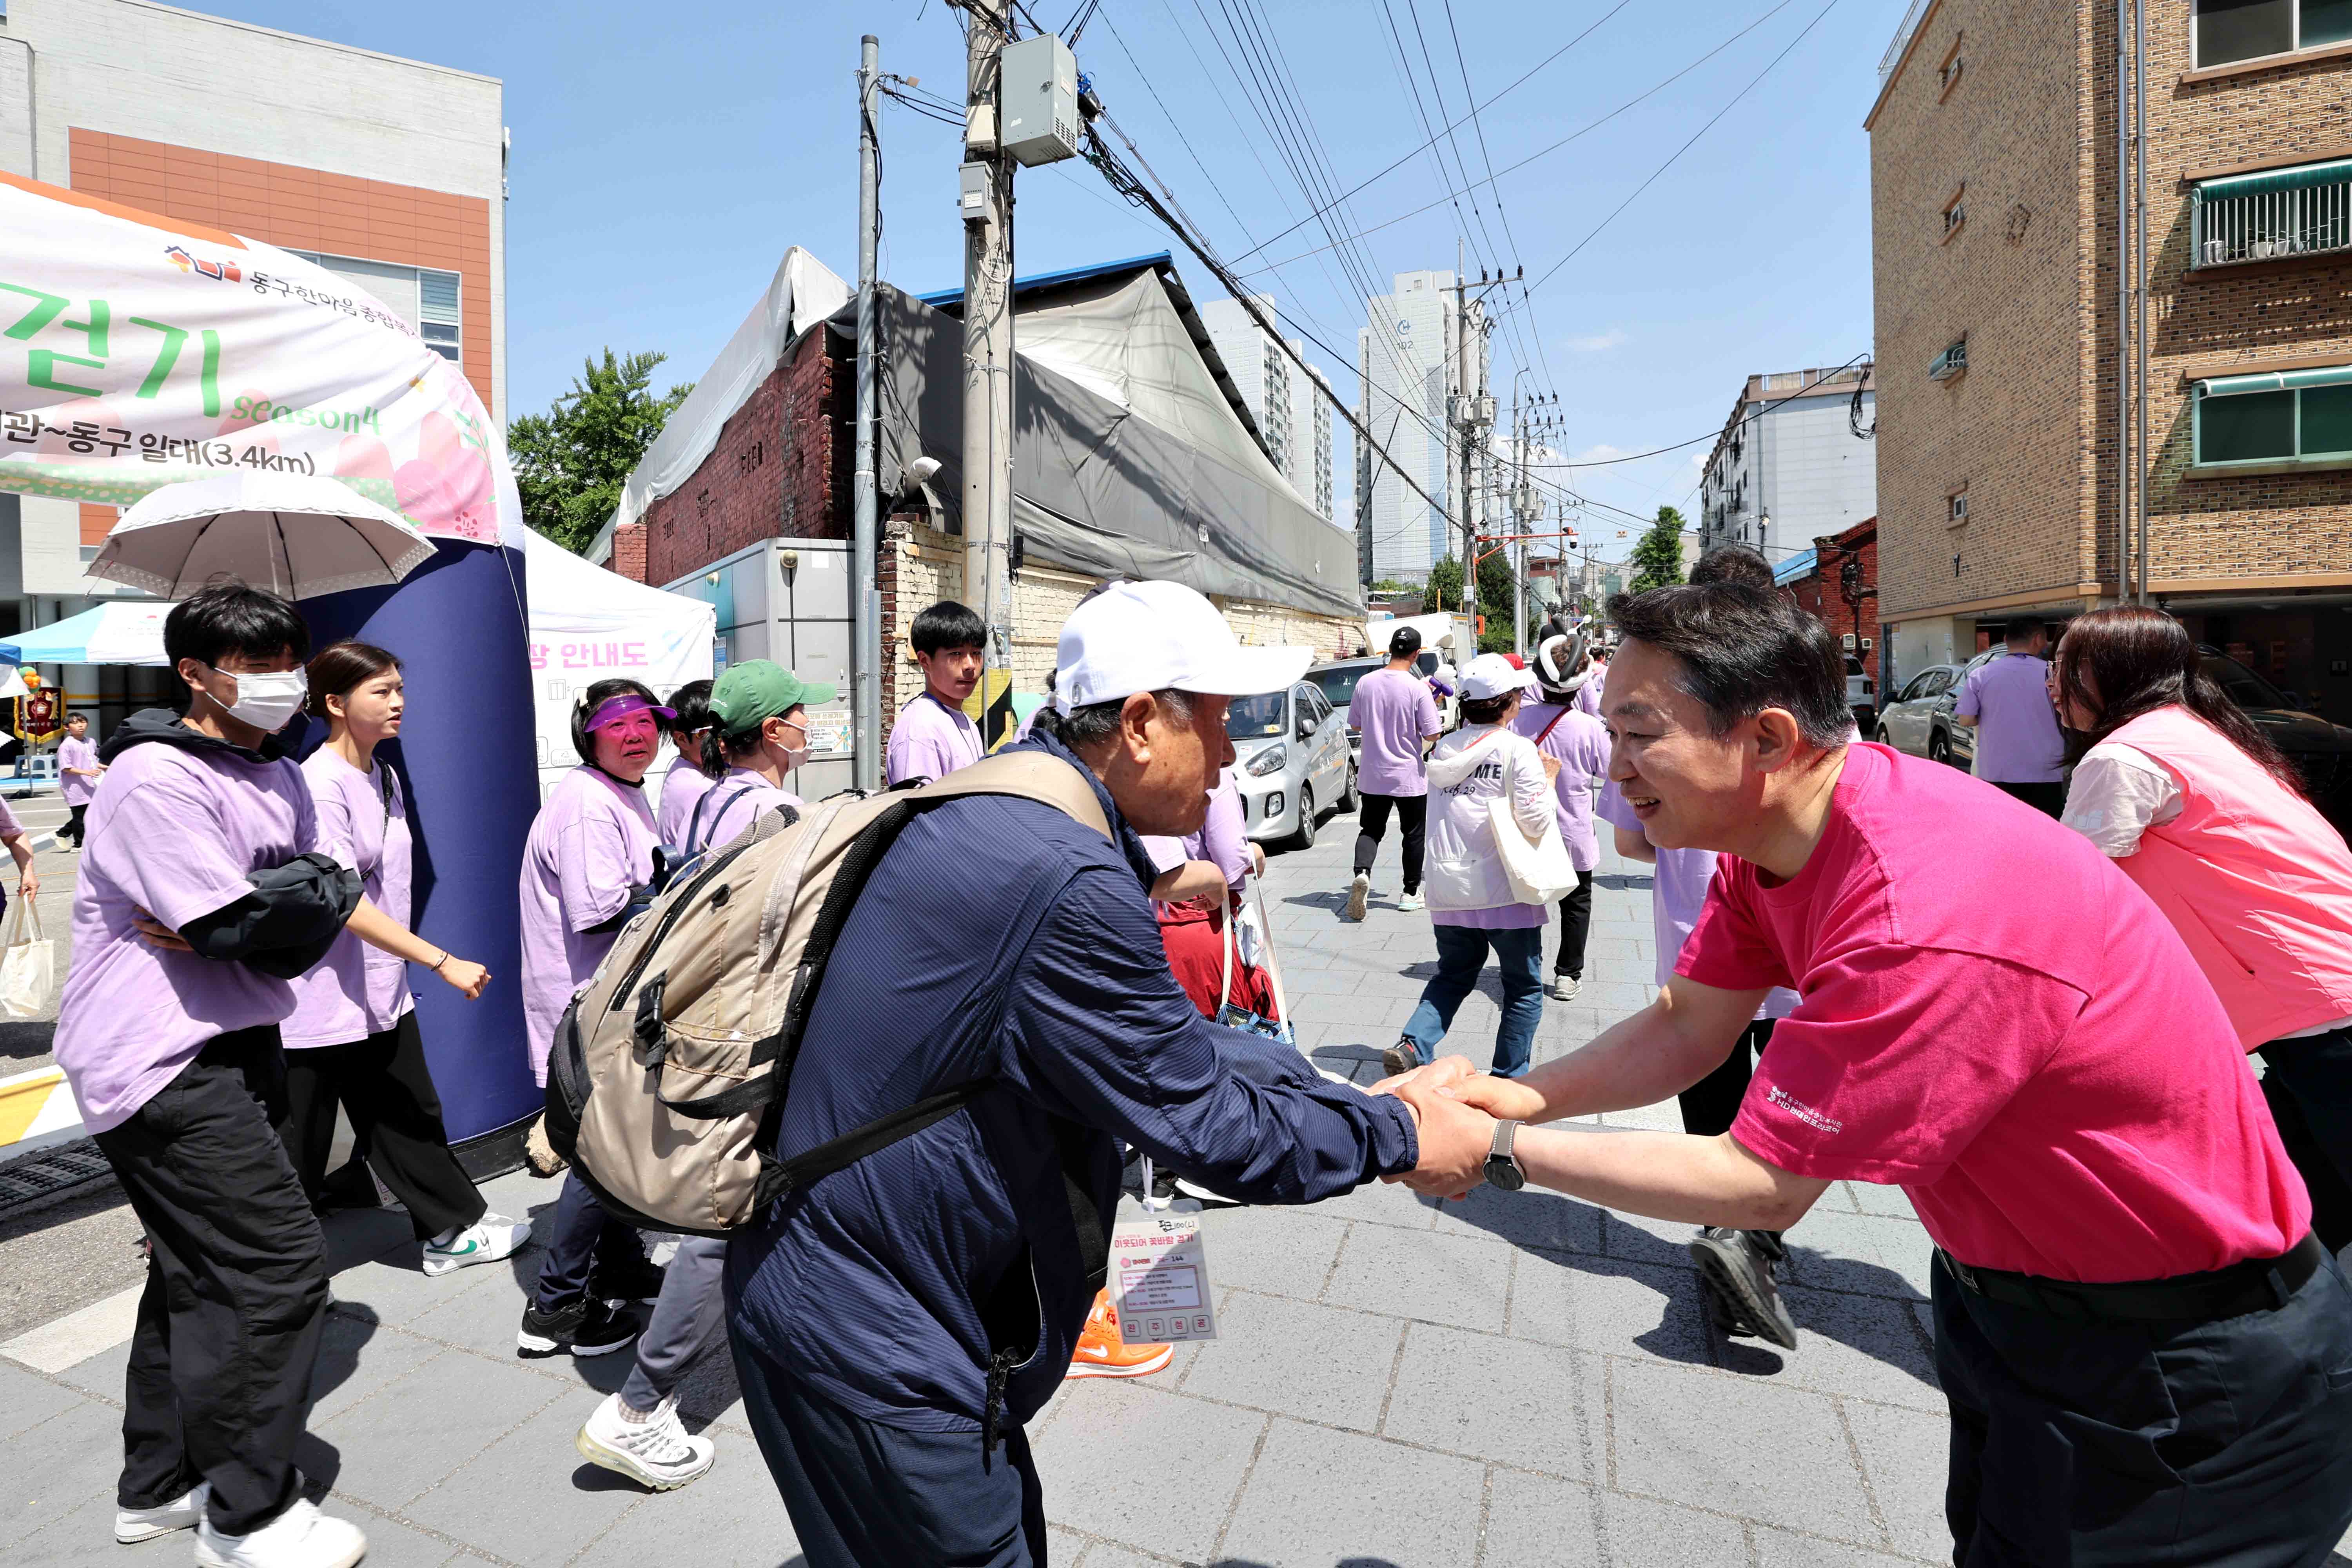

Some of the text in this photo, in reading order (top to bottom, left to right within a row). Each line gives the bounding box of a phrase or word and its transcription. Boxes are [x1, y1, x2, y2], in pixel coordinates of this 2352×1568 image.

[0, 282, 220, 418] 걷기
[230, 396, 383, 435] season4
[0, 410, 316, 475] 관~동구 일대(3.4km)
[561, 642, 648, 668] 안내도
[1467, 764, 1502, 779] ME
[1114, 1238, 1147, 1248] 이웃되어
